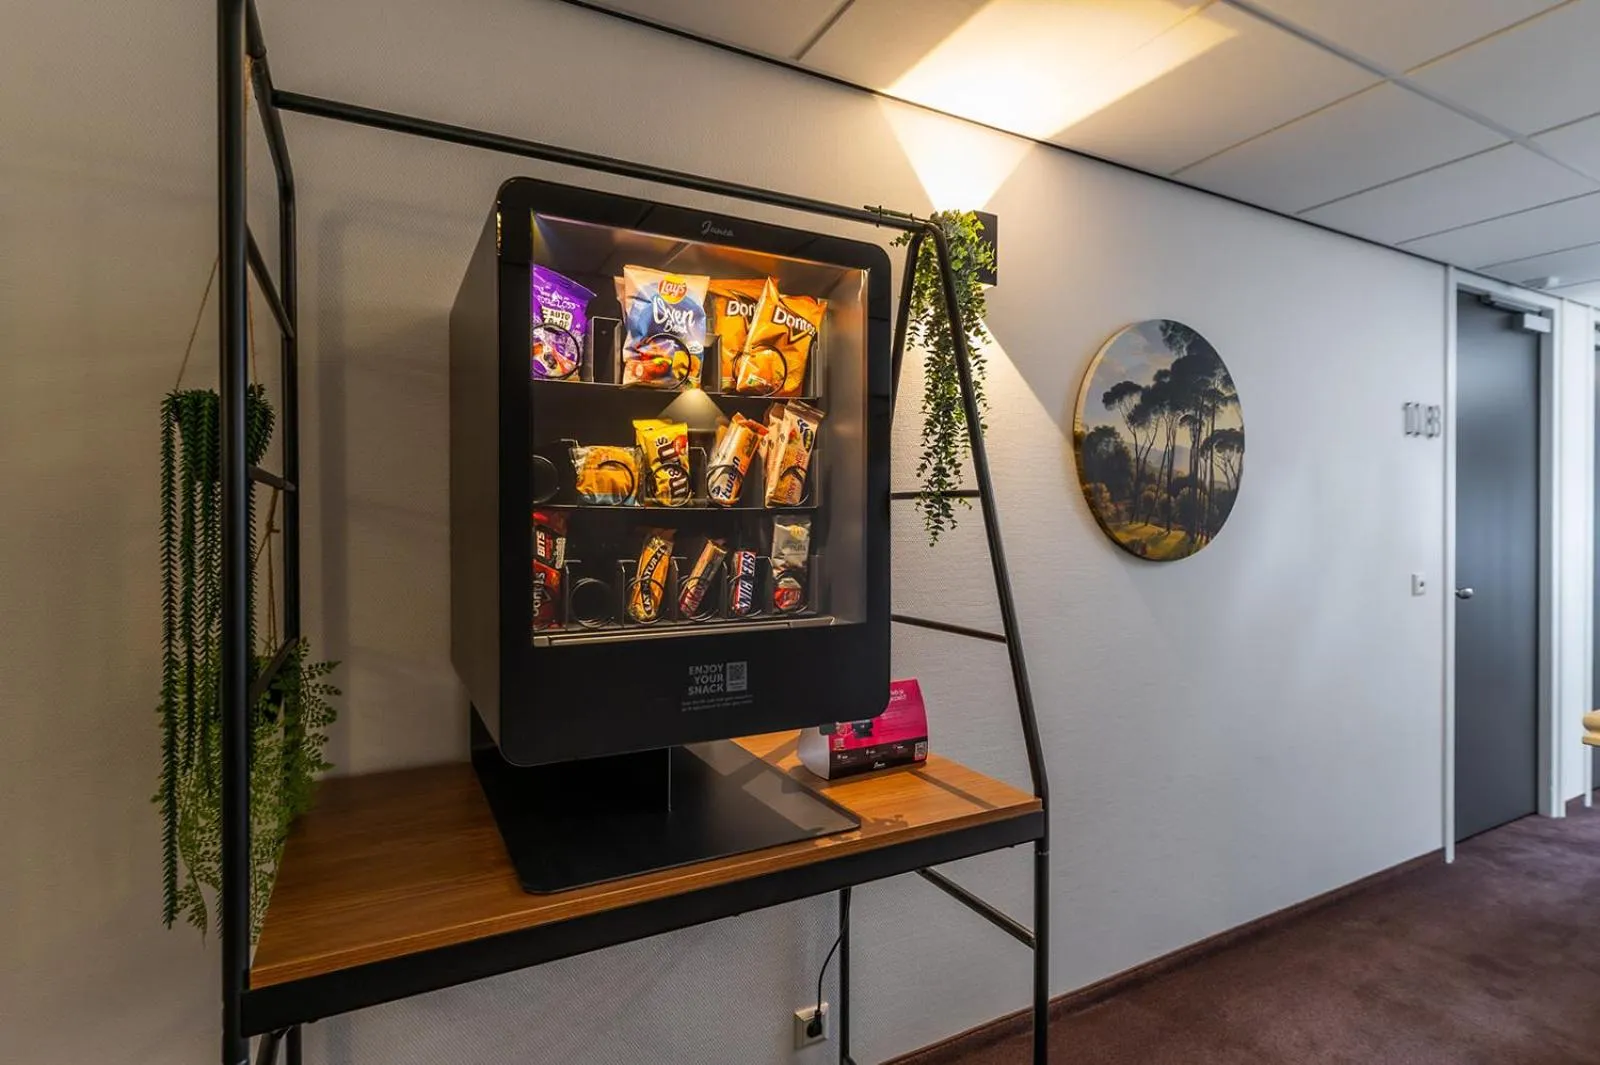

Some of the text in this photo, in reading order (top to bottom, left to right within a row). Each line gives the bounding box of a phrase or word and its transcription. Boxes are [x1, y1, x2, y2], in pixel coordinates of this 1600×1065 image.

[661, 280, 687, 297] Lay's
[653, 295, 697, 326] Oven
[727, 300, 757, 316] Dori
[536, 530, 546, 558] BITS
[641, 545, 667, 592] NTURAL
[688, 663, 724, 676] ENJOY
[694, 673, 724, 685] YOUR
[688, 683, 724, 696] SNACK
